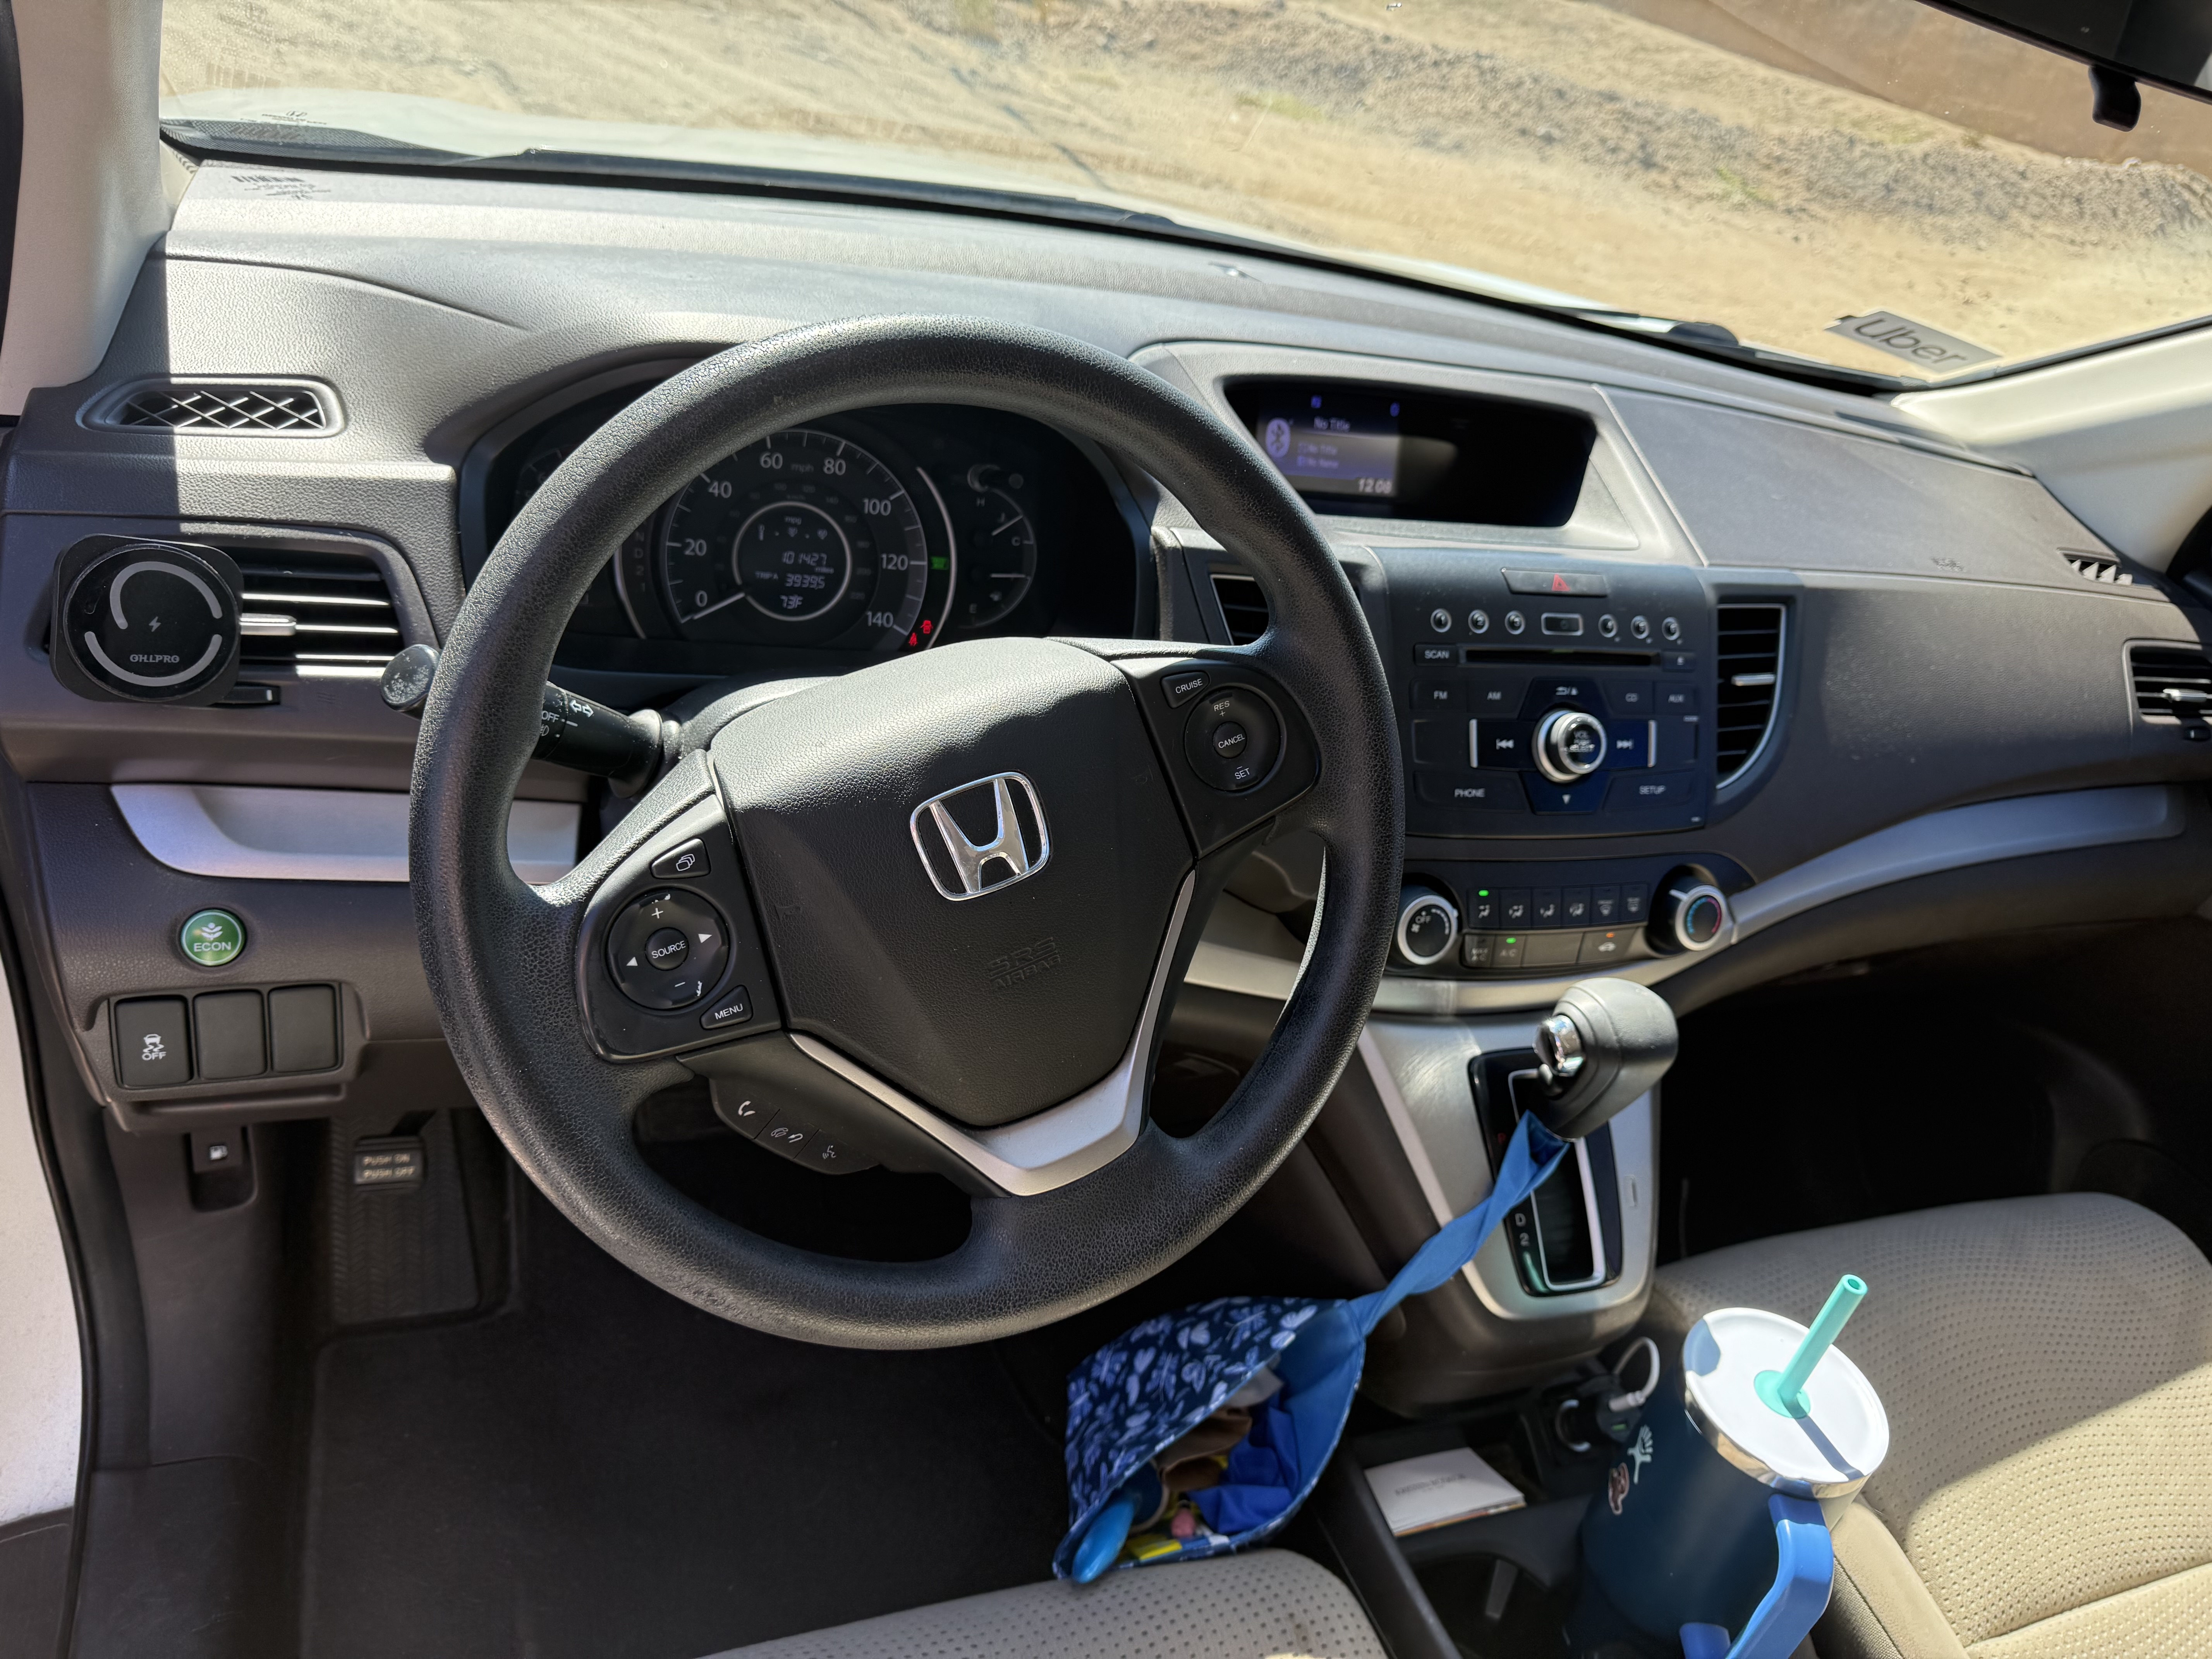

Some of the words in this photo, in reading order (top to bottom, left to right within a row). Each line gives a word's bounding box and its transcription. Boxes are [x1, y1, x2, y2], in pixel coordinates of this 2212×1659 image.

[1854, 318, 1968, 364] Uber
[760, 453, 783, 469] 60
[823, 459, 846, 476] 80
[708, 481, 732, 499] 40
[863, 499, 891, 516] 100
[976, 498, 986, 507] H
[684, 539, 707, 556] 20
[1012, 536, 1021, 546] C
[634, 547, 644, 559] D
[881, 553, 908, 571] 120
[636, 565, 644, 576] 2
[697, 591, 708, 607] 0
[866, 611, 894, 628] 140
[1425, 650, 1449, 659] SCAN
[1175, 679, 1203, 694] CRUISE
[1434, 691, 1447, 699] FM
[1487, 692, 1501, 700] AM
[1214, 701, 1230, 711] RES
[541, 711, 560, 723] OFF
[1218, 734, 1245, 748] CANCEL
[1235, 768, 1250, 780] SET
[1455, 788, 1485, 798] PHONE
[1639, 786, 1666, 794] SETUP
[1415, 915, 1431, 924] OFF
[194, 942, 231, 952] ECON
[652, 940, 686, 958] SOURCE
[988, 937, 1055, 975] SRS
[714, 1003, 744, 1020] MENU
[142, 1052, 166, 1061] OFF
[1514, 1212, 1527, 1227] D
[1519, 1232, 1530, 1247] 2
